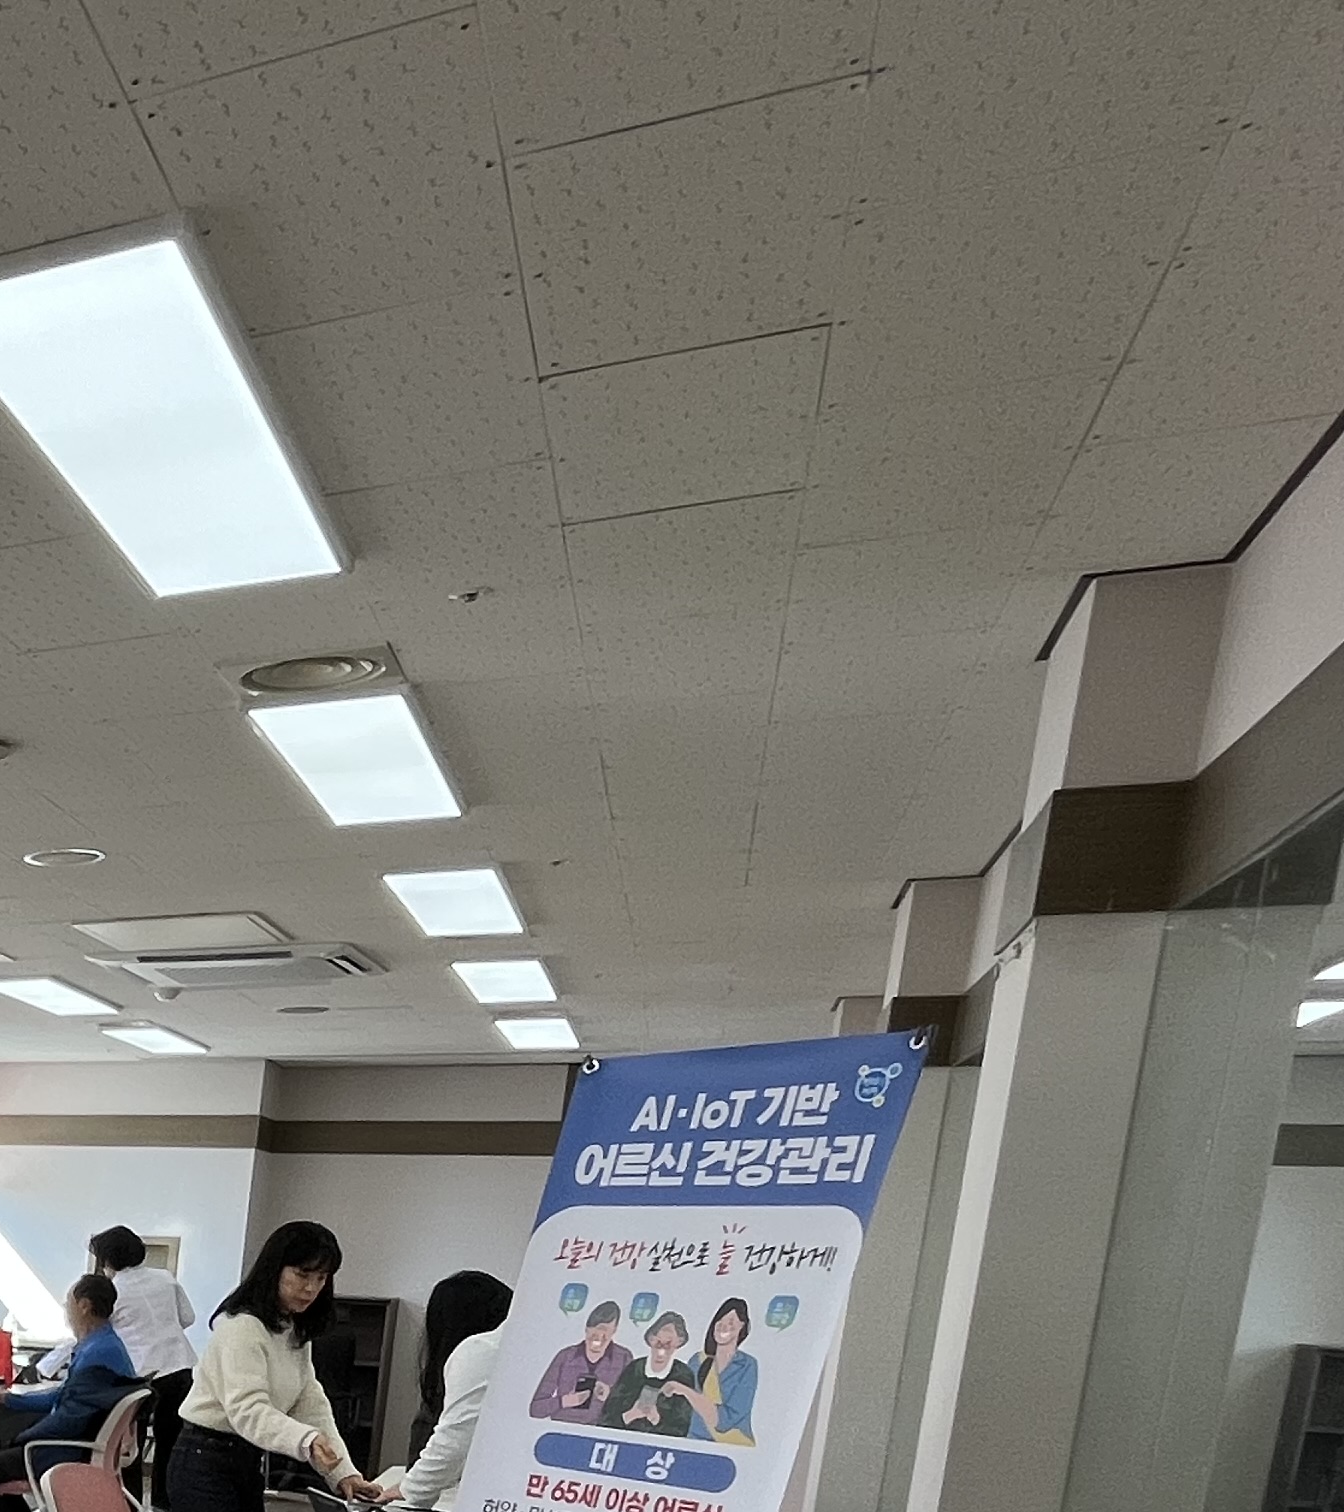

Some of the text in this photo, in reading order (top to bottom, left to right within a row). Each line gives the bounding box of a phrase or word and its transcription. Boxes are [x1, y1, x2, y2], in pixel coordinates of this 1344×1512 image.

[756, 1082, 839, 1127] 기반
[574, 1134, 877, 1187] 어르신 건강관리
[553, 1236, 604, 1270] 오늘의
[608, 1240, 647, 1270] 건강
[647, 1237, 710, 1272] 실천으로
[716, 1239, 736, 1275] 늘
[526, 1474, 548, 1499] 만
[551, 1481, 602, 1509] 65세
